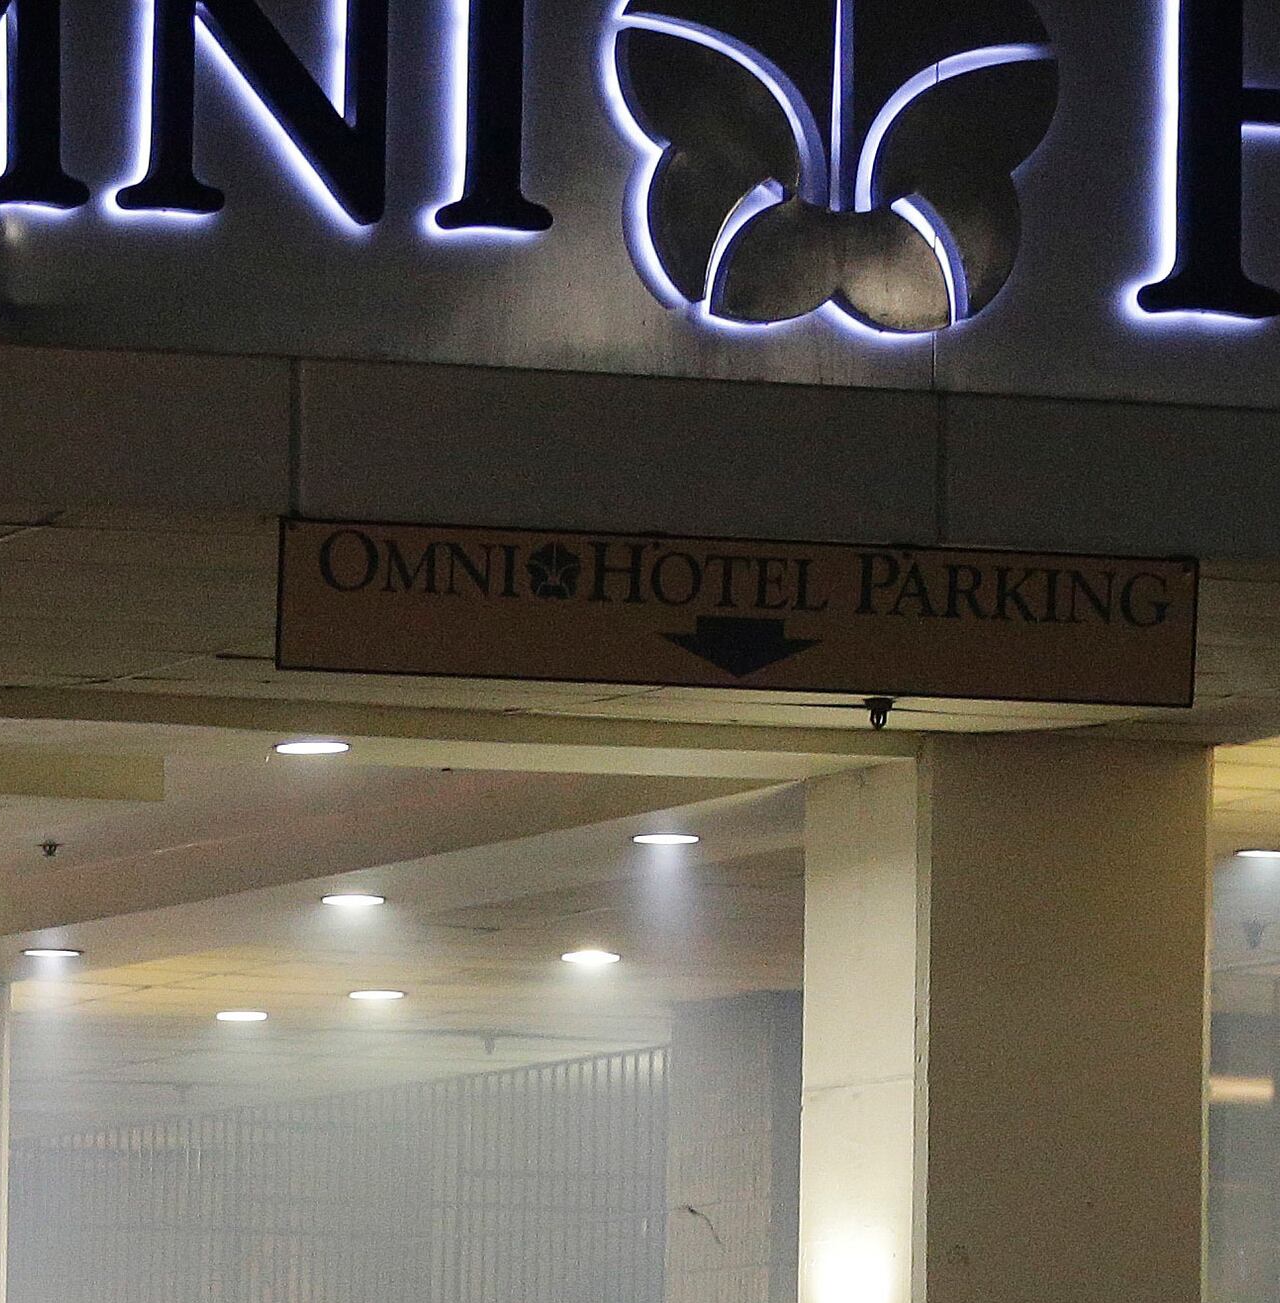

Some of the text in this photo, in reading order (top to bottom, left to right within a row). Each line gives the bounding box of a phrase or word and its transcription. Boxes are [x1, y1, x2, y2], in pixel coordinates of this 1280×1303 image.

[319, 528, 1173, 628] OMNI HOTEL PARKING
